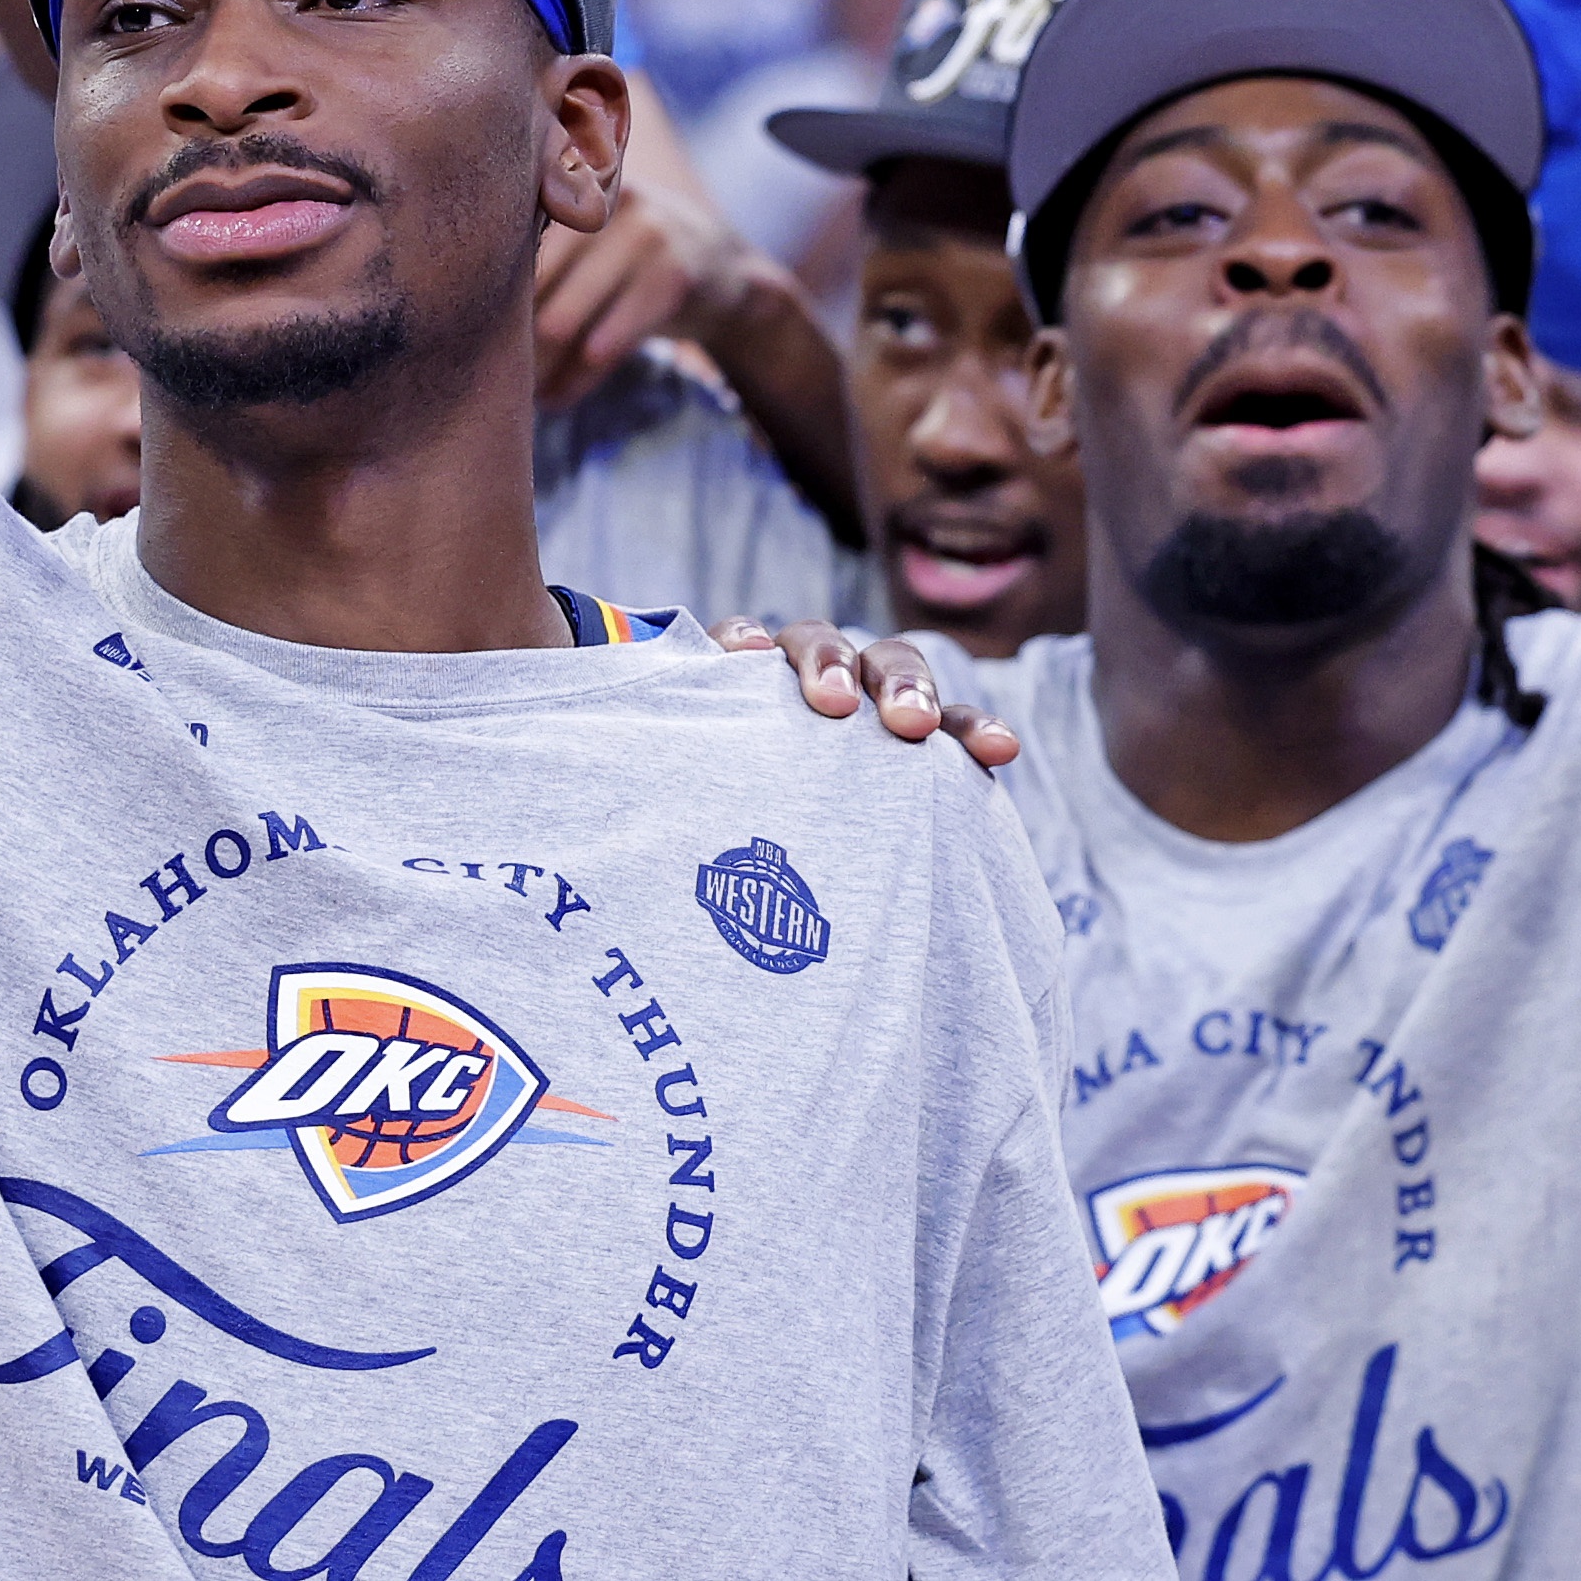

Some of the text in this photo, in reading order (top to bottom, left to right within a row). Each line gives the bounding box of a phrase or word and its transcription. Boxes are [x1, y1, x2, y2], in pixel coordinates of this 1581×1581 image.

[755, 840, 783, 866] NBA
[705, 869, 823, 952] WESTERN
[20, 810, 715, 1369] OKLAHOM CITY THUNDER
[226, 1031, 487, 1124] OKC
